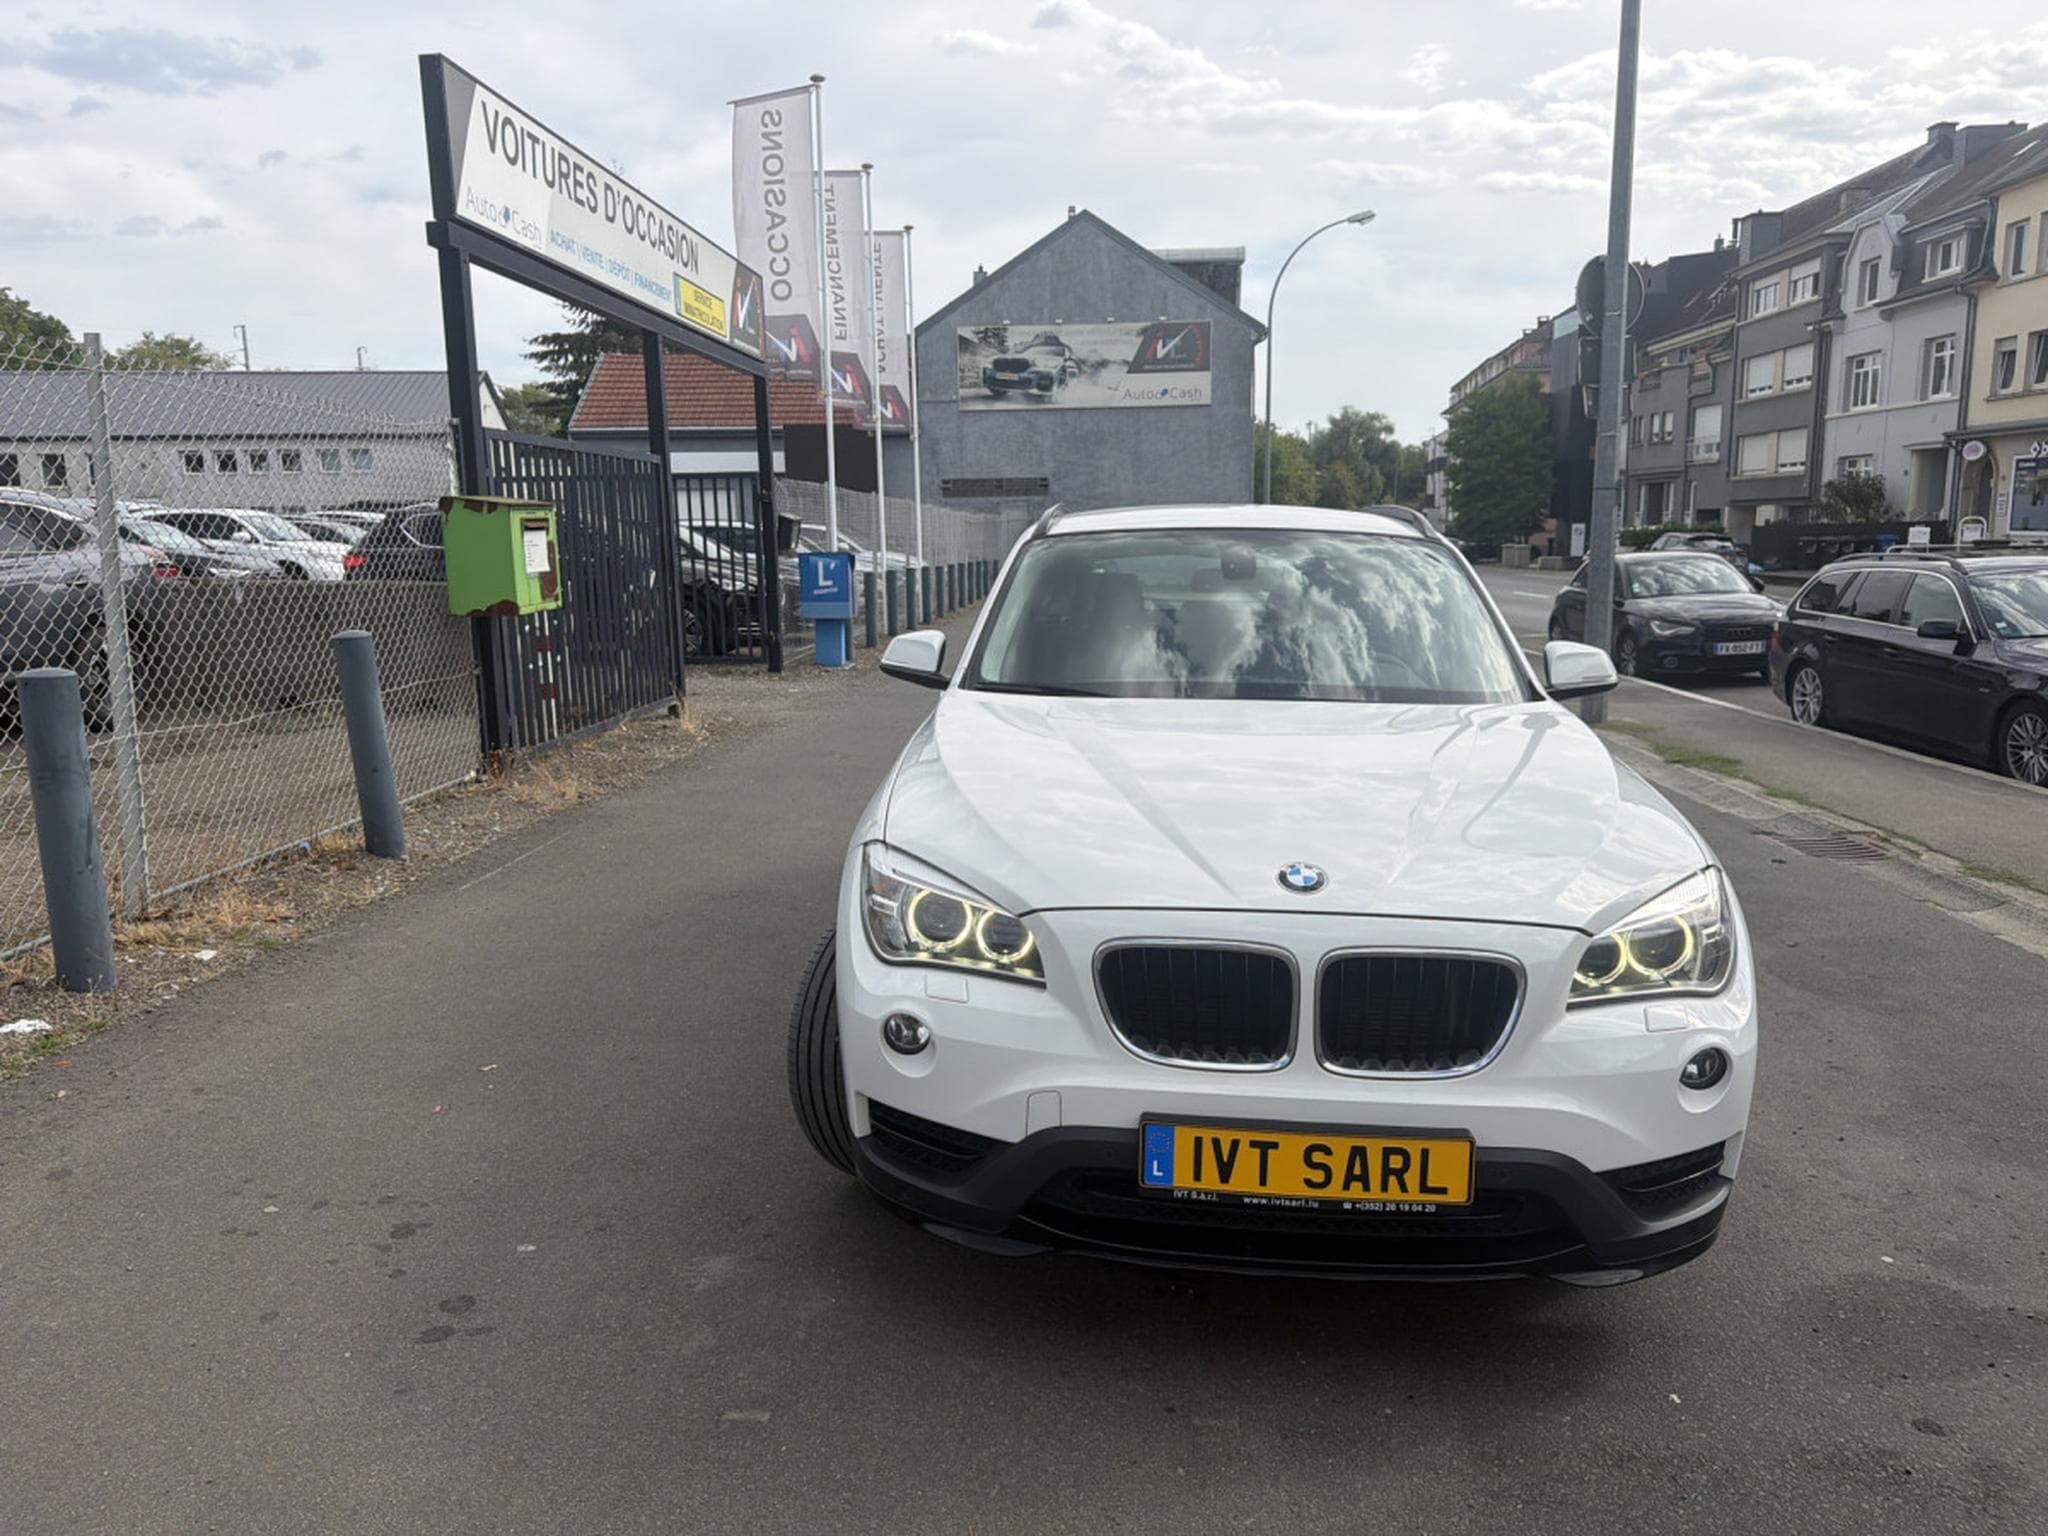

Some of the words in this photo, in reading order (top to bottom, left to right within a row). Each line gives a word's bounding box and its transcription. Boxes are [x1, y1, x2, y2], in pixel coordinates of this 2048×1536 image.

[481, 99, 598, 214] VOITURES
[604, 181, 699, 275] D'OCCASION
[1152, 1160, 1164, 1176] L
[1193, 1135, 1279, 1187] IVT
[1302, 1143, 1448, 1195] SARL
